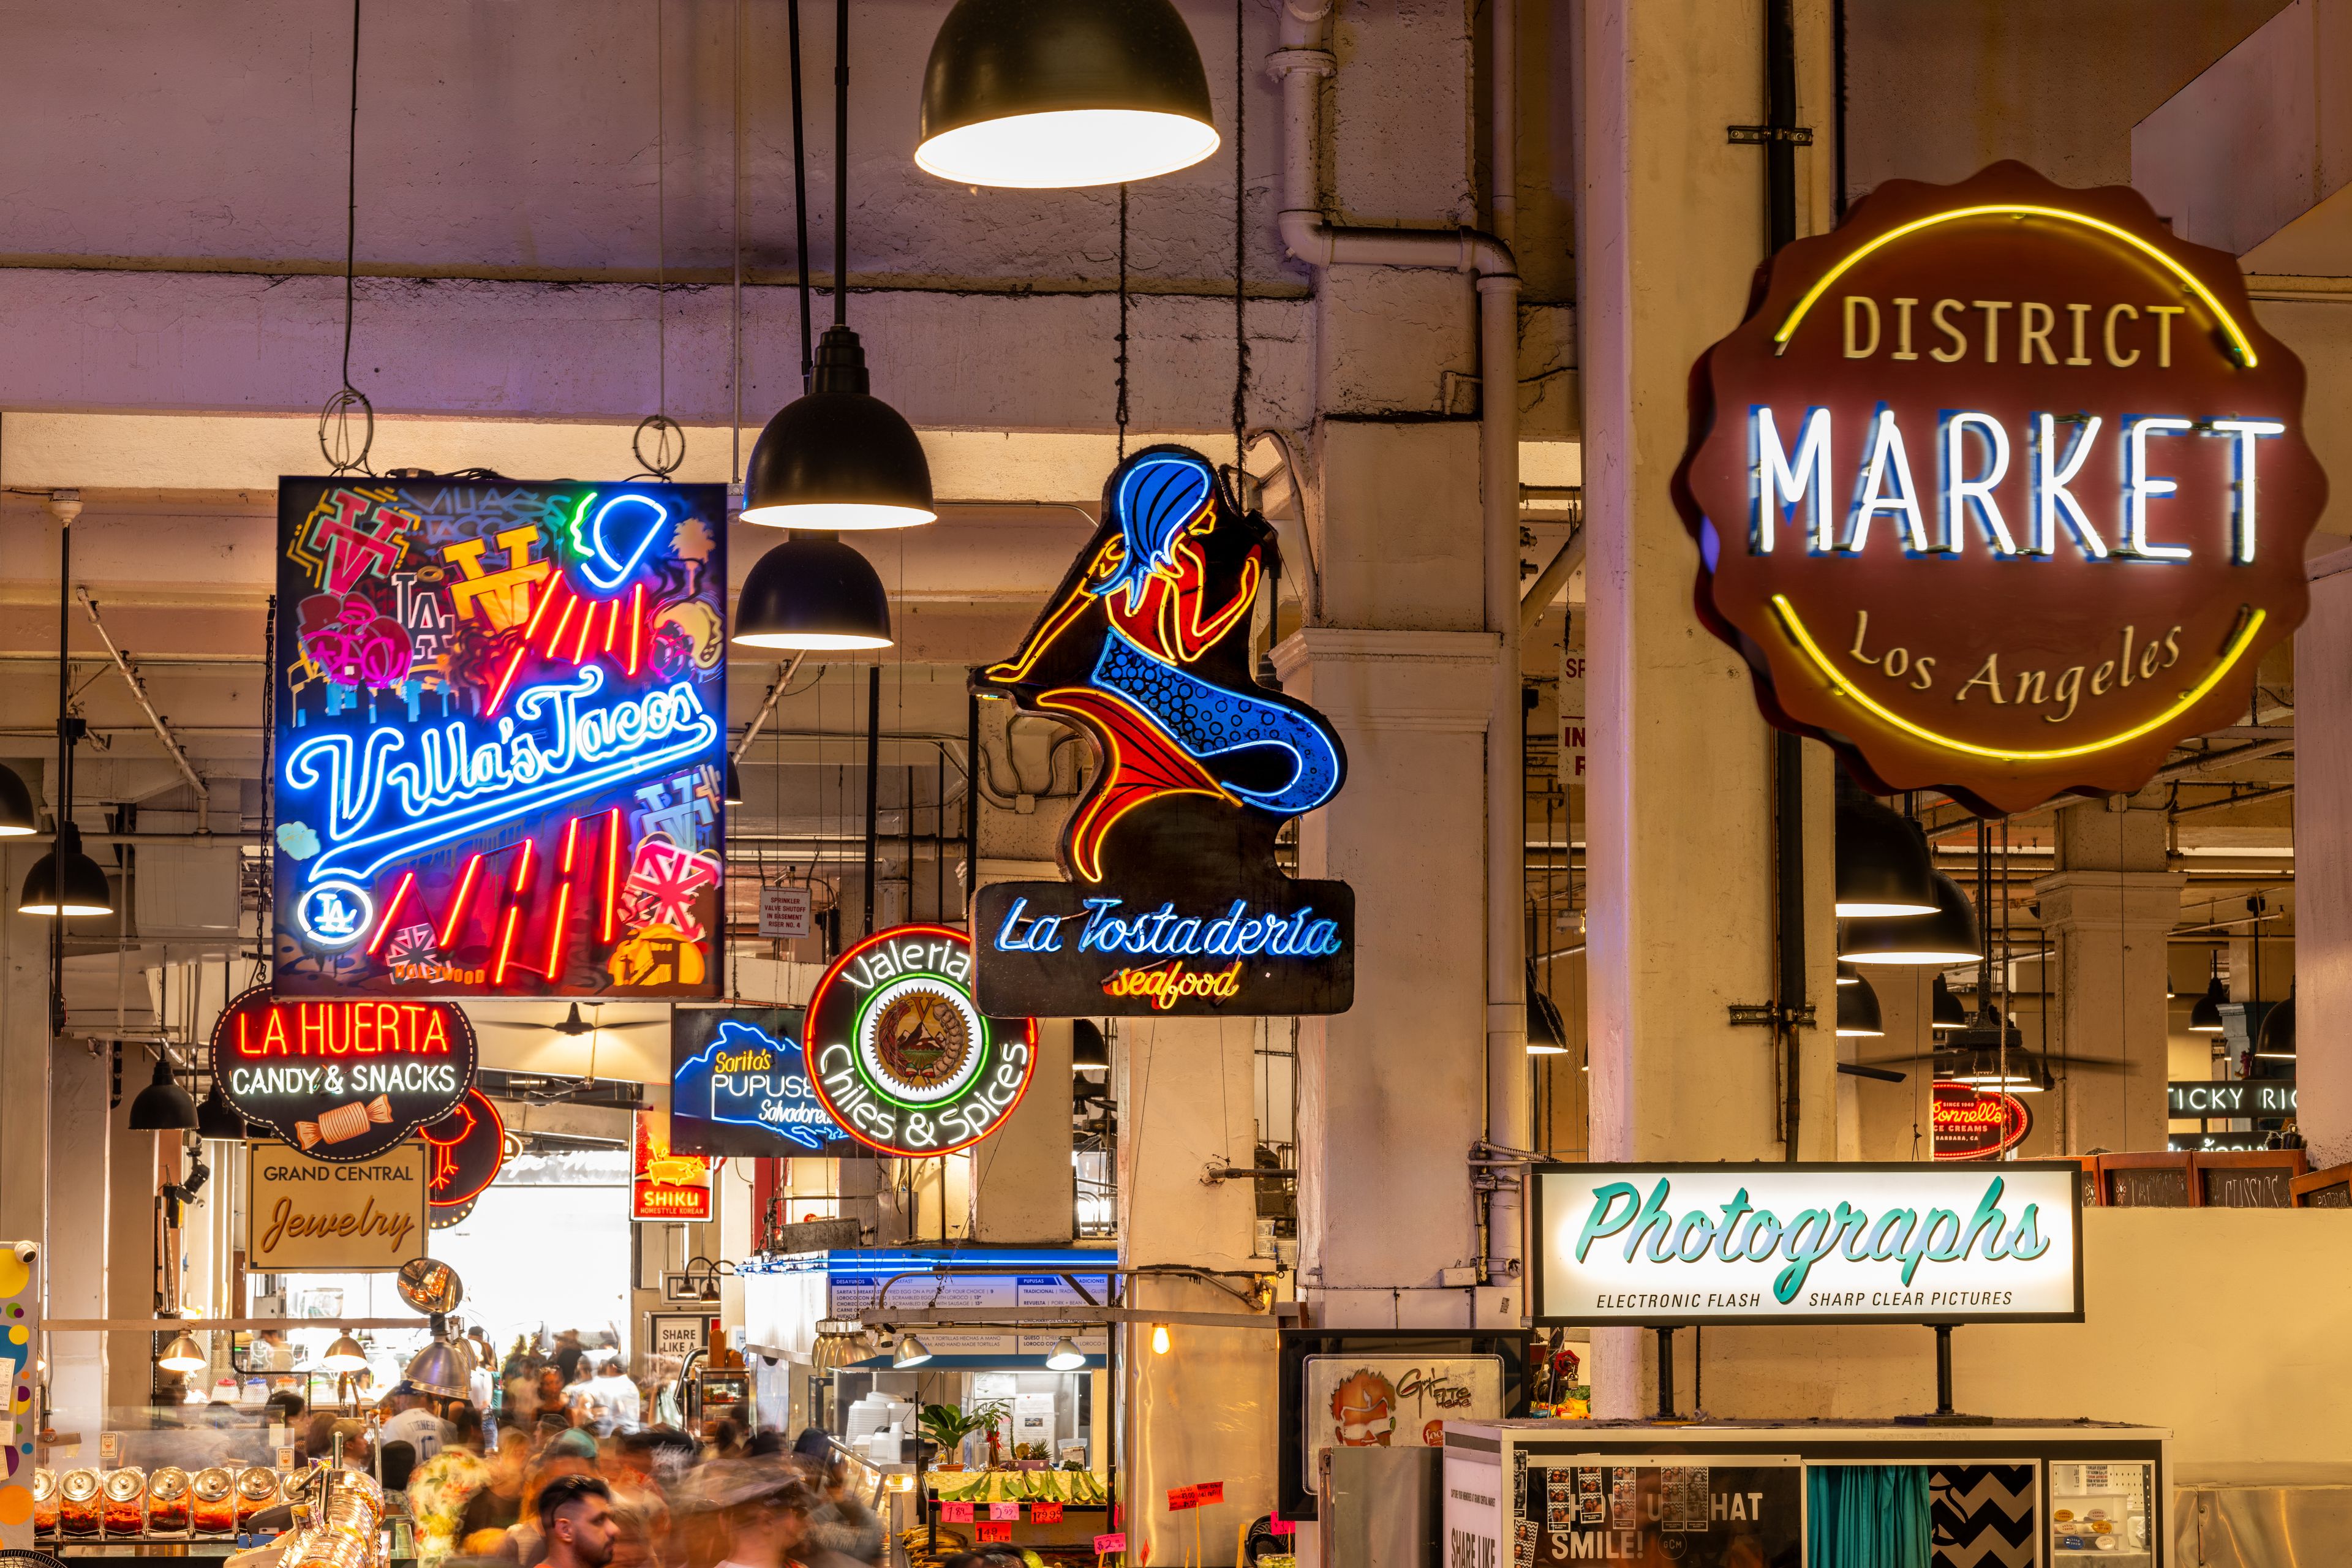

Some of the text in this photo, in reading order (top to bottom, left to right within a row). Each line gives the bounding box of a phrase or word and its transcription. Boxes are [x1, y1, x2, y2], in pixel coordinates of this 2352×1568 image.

[1843, 295, 2185, 368] DISTRICT
[1753, 403, 2285, 564] MARKET
[1849, 609, 2184, 723] Los Angeles
[286, 665, 704, 841] Villa's Tacos
[995, 897, 1343, 956] La Tostadería
[394, 963, 486, 985] HOLLYWOOD
[841, 940, 970, 990] Valeria
[1110, 960, 1243, 1010] seafood
[240, 1003, 450, 1055] LA HUERTA
[232, 1063, 456, 1095] CANDY & SNACKS
[820, 1043, 1028, 1147] Chiles & Spices
[263, 1166, 414, 1182] GRAND CENTRAL
[644, 1191, 699, 1207] SHIKU
[260, 1195, 415, 1254] Jewelry
[1575, 1175, 2051, 1305] Photographs
[1596, 1291, 2013, 1309] ELECTRONIC FLASH SHARP CLEAR PICTURES
[662, 1329, 696, 1340] SHARE
[663, 1342, 695, 1352] LIKE A
[1647, 1493, 1662, 1521] U
[1711, 1493, 1763, 1521] HAT
[976, 1527, 998, 1542] 1.49
[1451, 1527, 1476, 1568] SHARE
[1551, 1531, 1644, 1559] SMILE!
[1663, 1539, 1682, 1550] GCM
